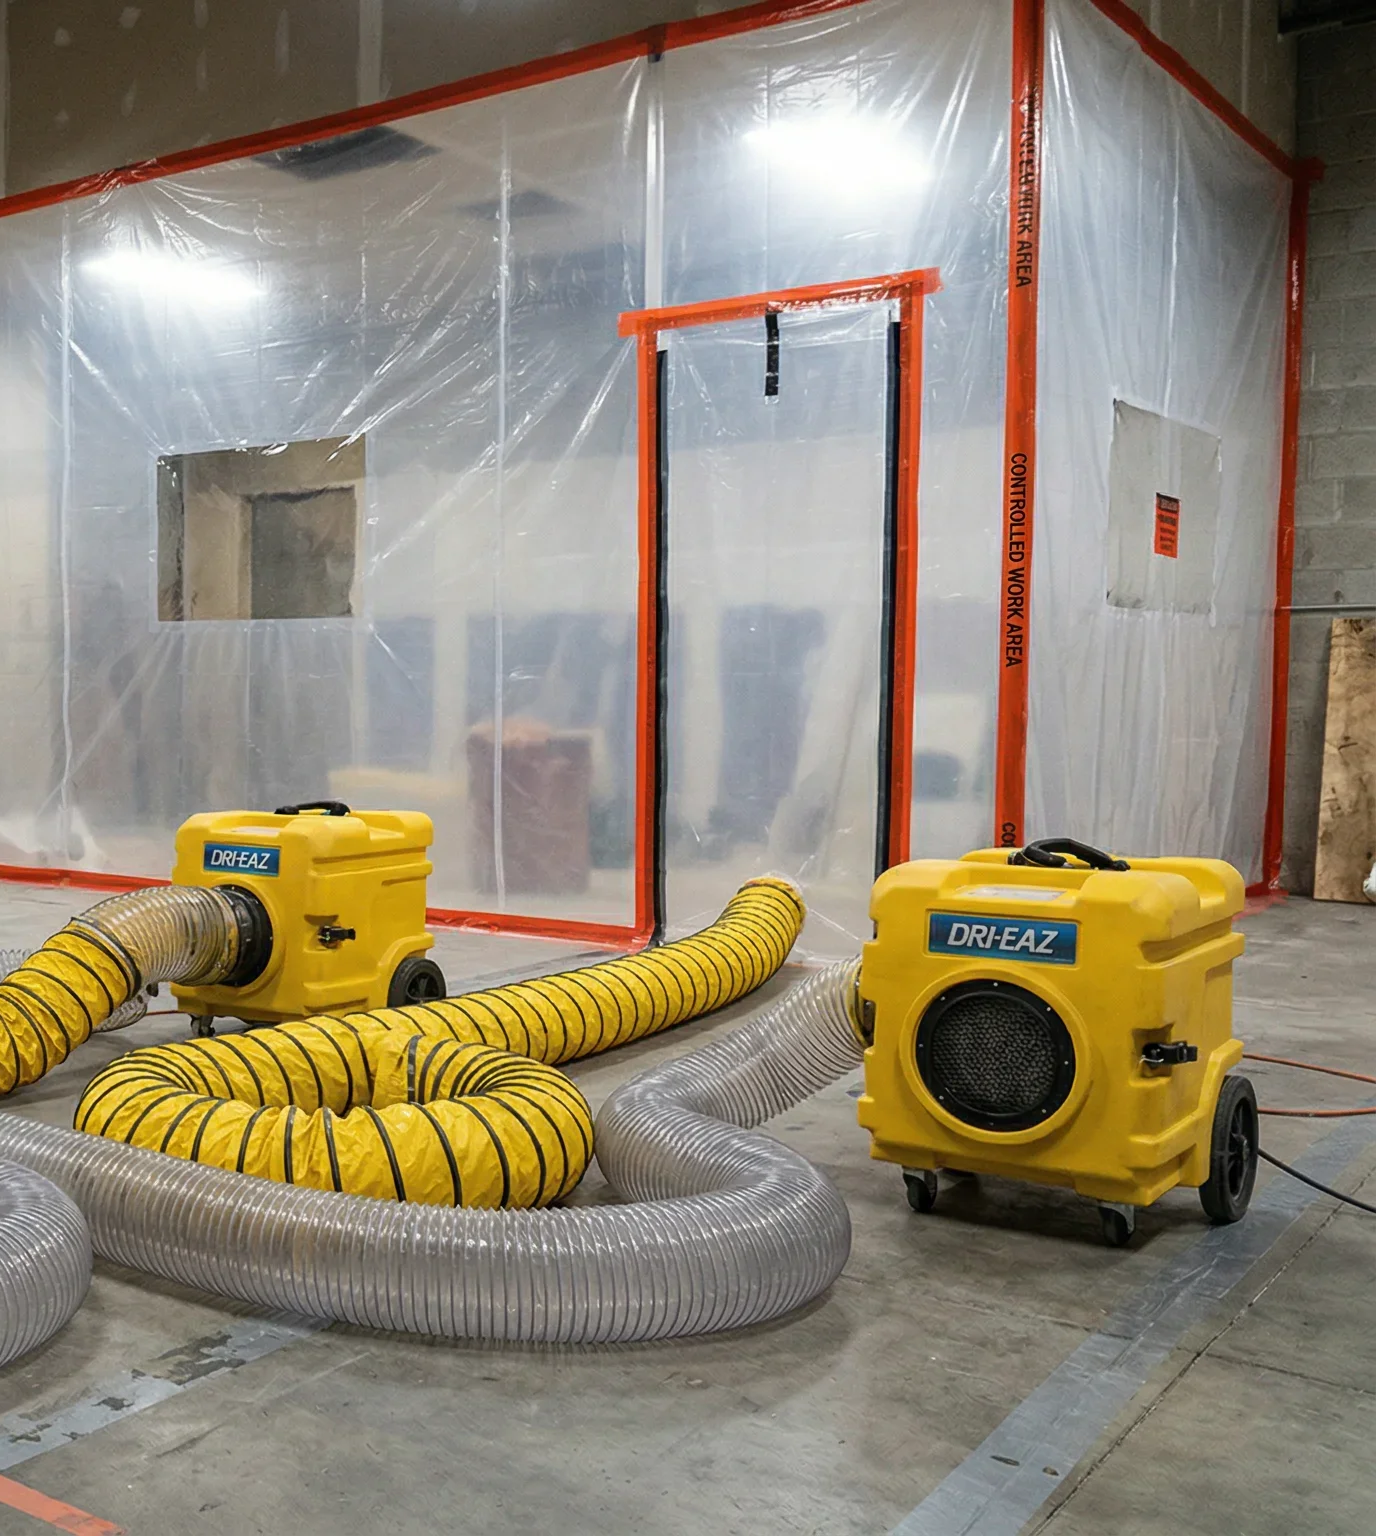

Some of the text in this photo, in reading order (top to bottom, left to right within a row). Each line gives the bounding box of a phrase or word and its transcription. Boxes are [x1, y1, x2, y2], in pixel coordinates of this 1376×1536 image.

[1016, 240, 1032, 288] AREA
[1005, 453, 1027, 668] CONTROLLED WORK AREA
[210, 849, 271, 870] DRI-EAZ
[947, 922, 1059, 954] DRI-EAZ
